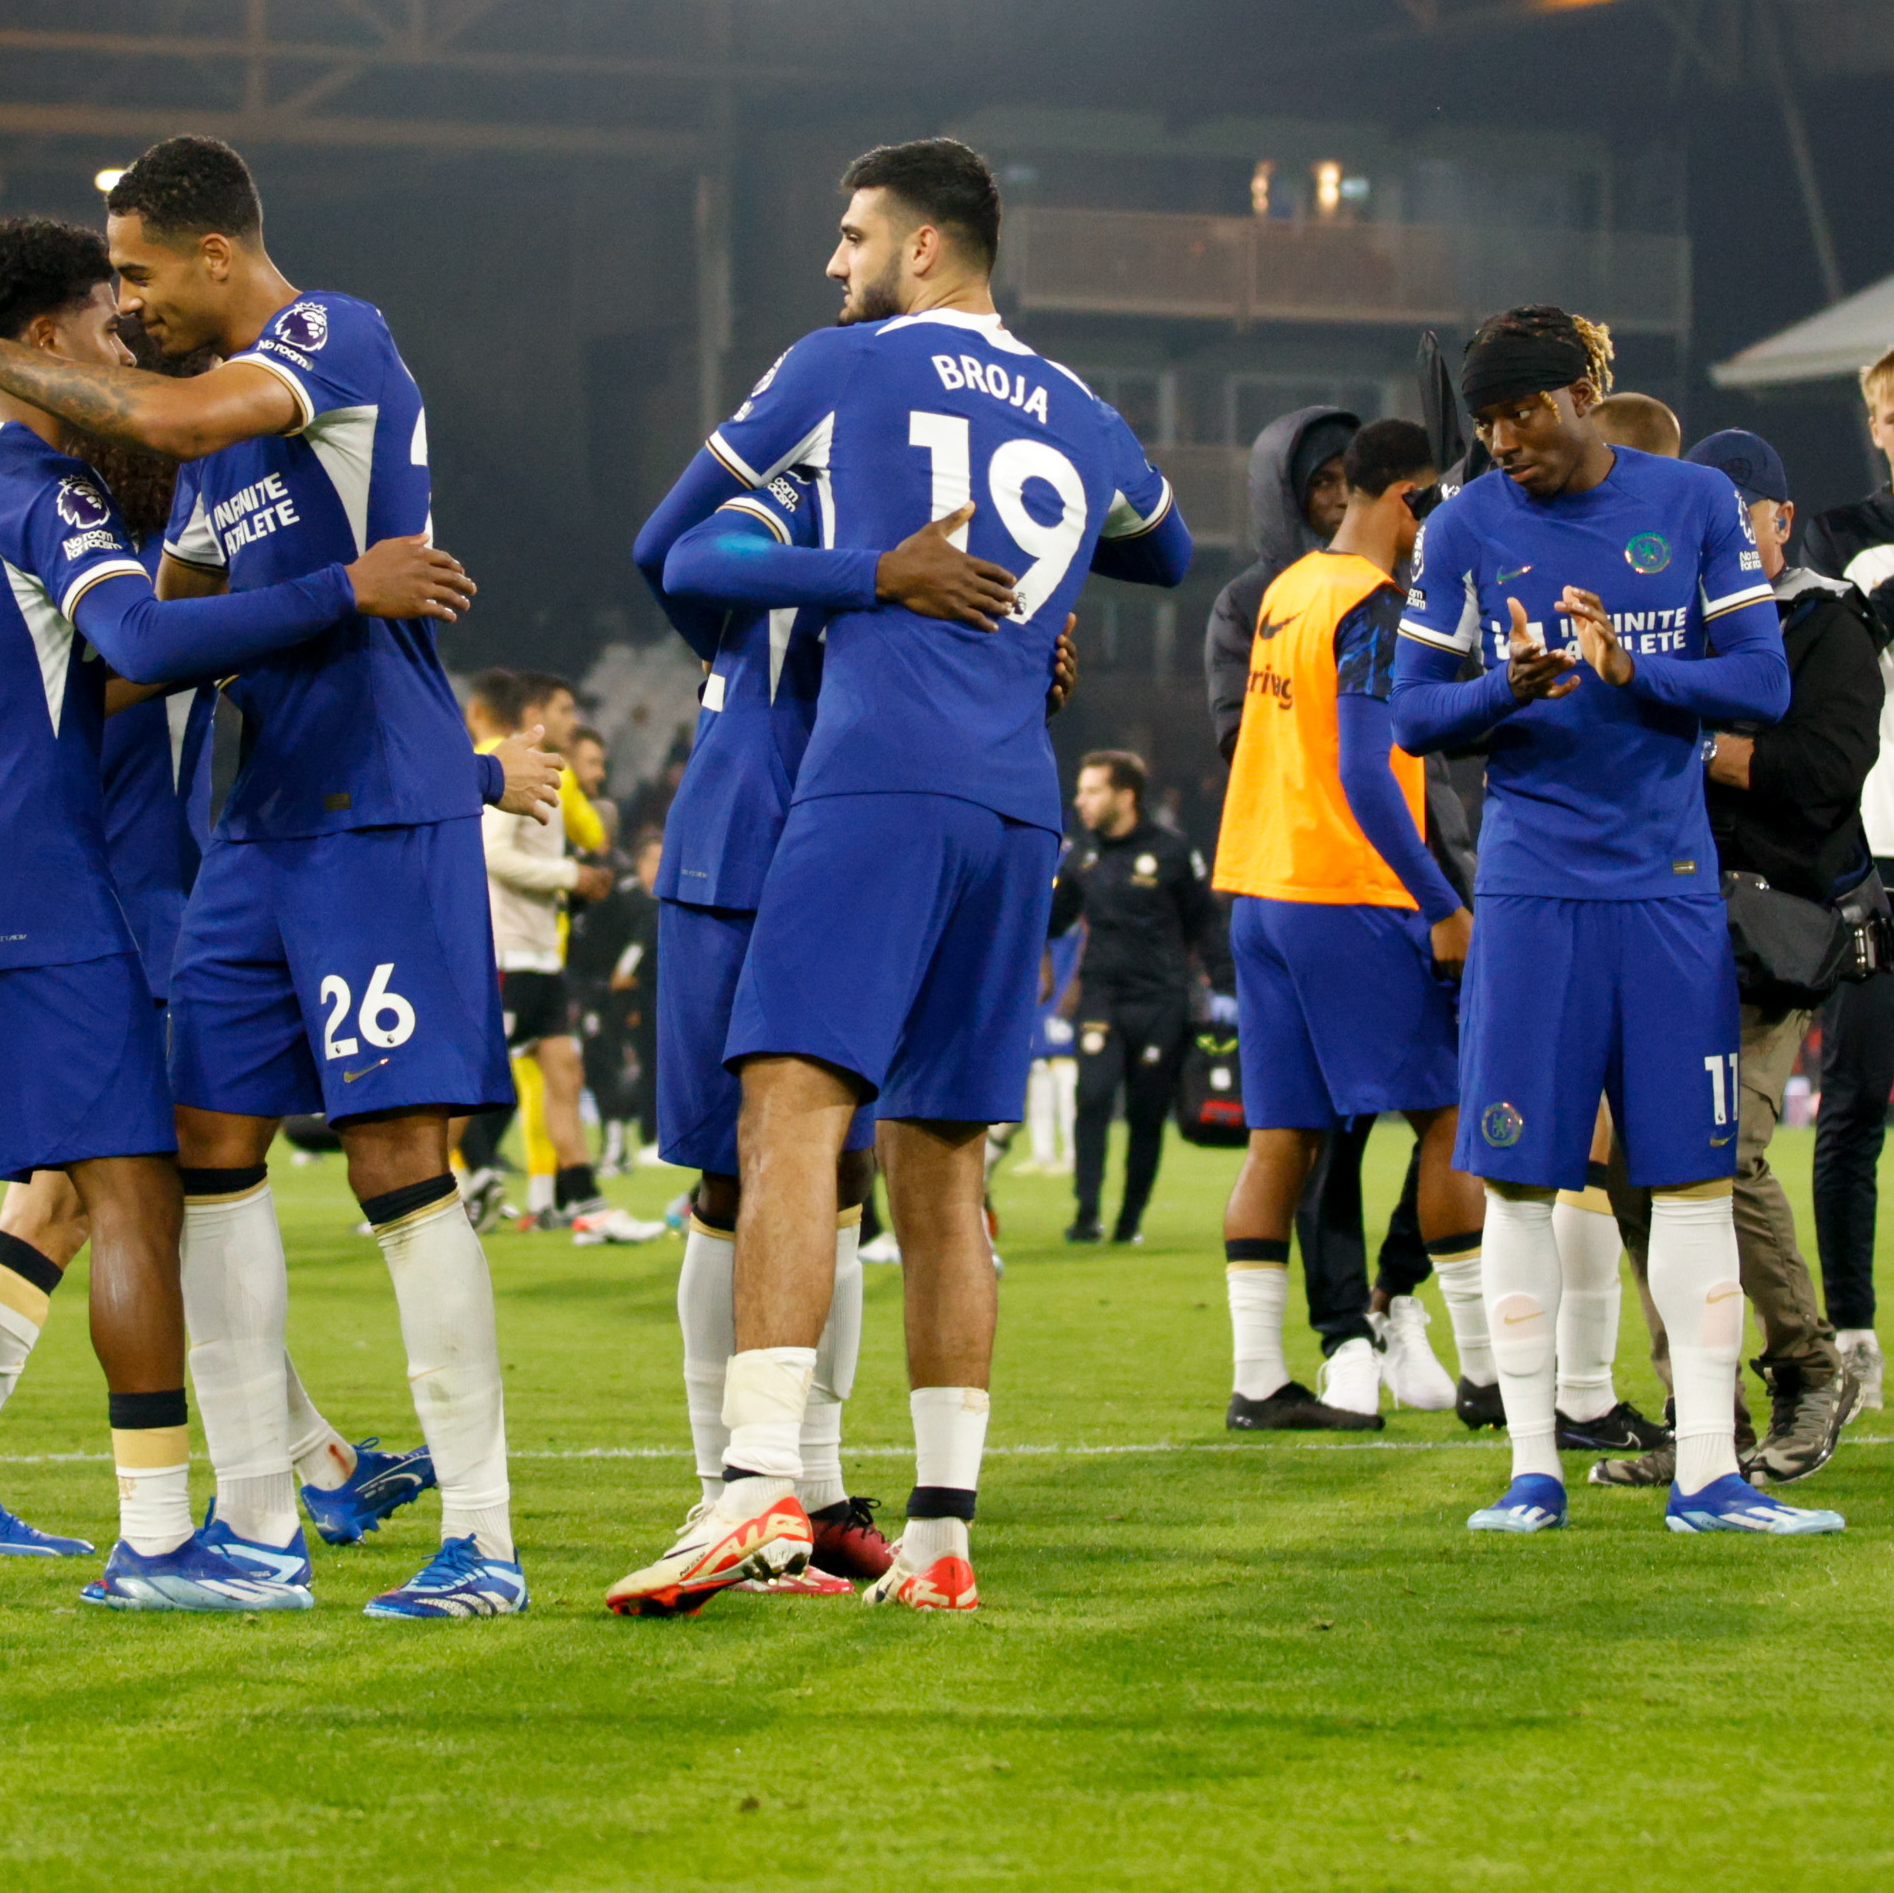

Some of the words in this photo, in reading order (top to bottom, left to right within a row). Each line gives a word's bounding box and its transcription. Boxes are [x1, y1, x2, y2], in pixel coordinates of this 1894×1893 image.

[931, 355, 1048, 424] BROJA
[774, 477, 799, 503] oom
[909, 411, 1088, 625] 19
[82, 529, 114, 543] room
[320, 962, 416, 1061] 26
[1704, 1052, 1738, 1125] 11
